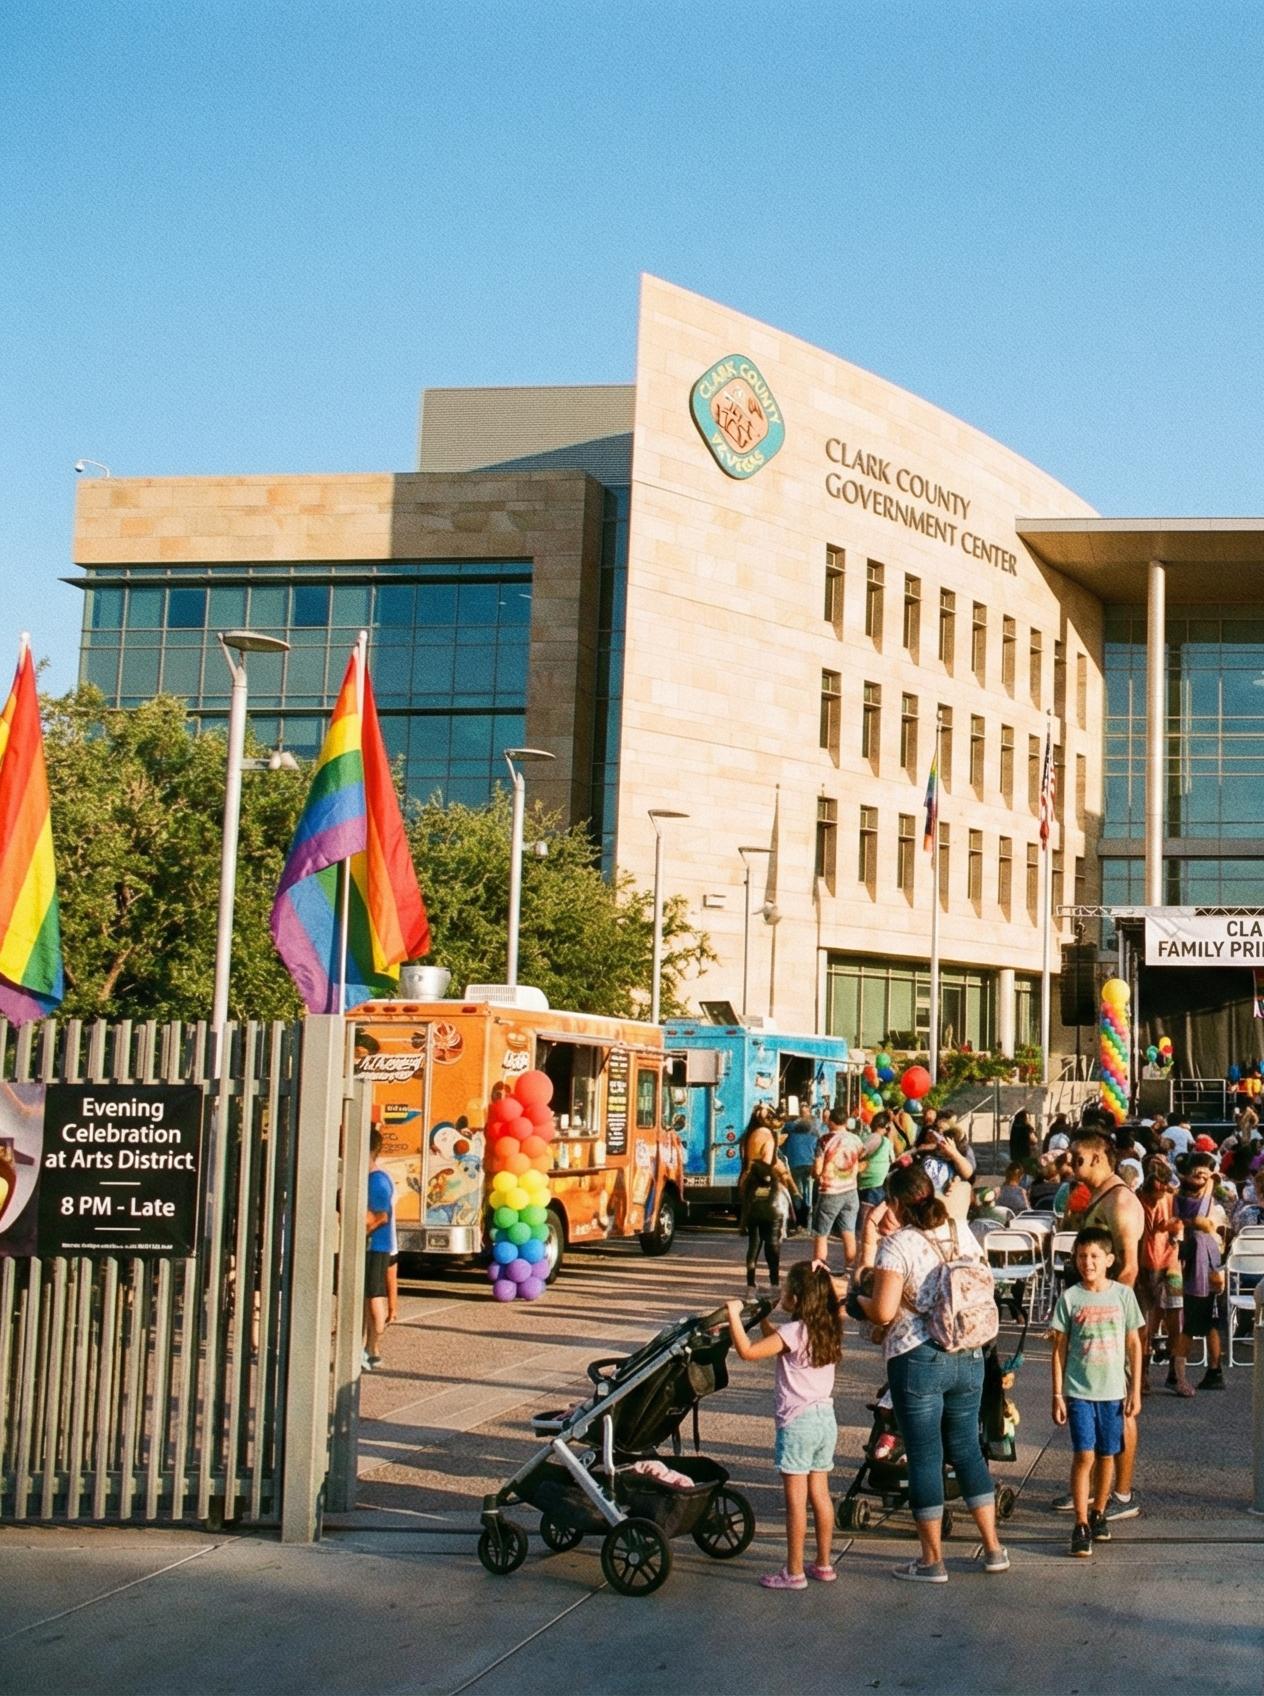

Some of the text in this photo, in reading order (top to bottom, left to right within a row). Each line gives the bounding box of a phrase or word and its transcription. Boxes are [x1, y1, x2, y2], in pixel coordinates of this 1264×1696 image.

[825, 437, 971, 520] CLARK COUNTY
[825, 472, 1018, 577] GOVERNMENT CENTER
[1158, 940, 1225, 958] FAMILY
[82, 1097, 165, 1122] Evening
[61, 1123, 182, 1144] Celebration
[45, 1149, 195, 1170] at Arts District
[60, 1196, 74, 1216] 8
[79, 1196, 112, 1216] PM
[130, 1197, 176, 1217] Late
